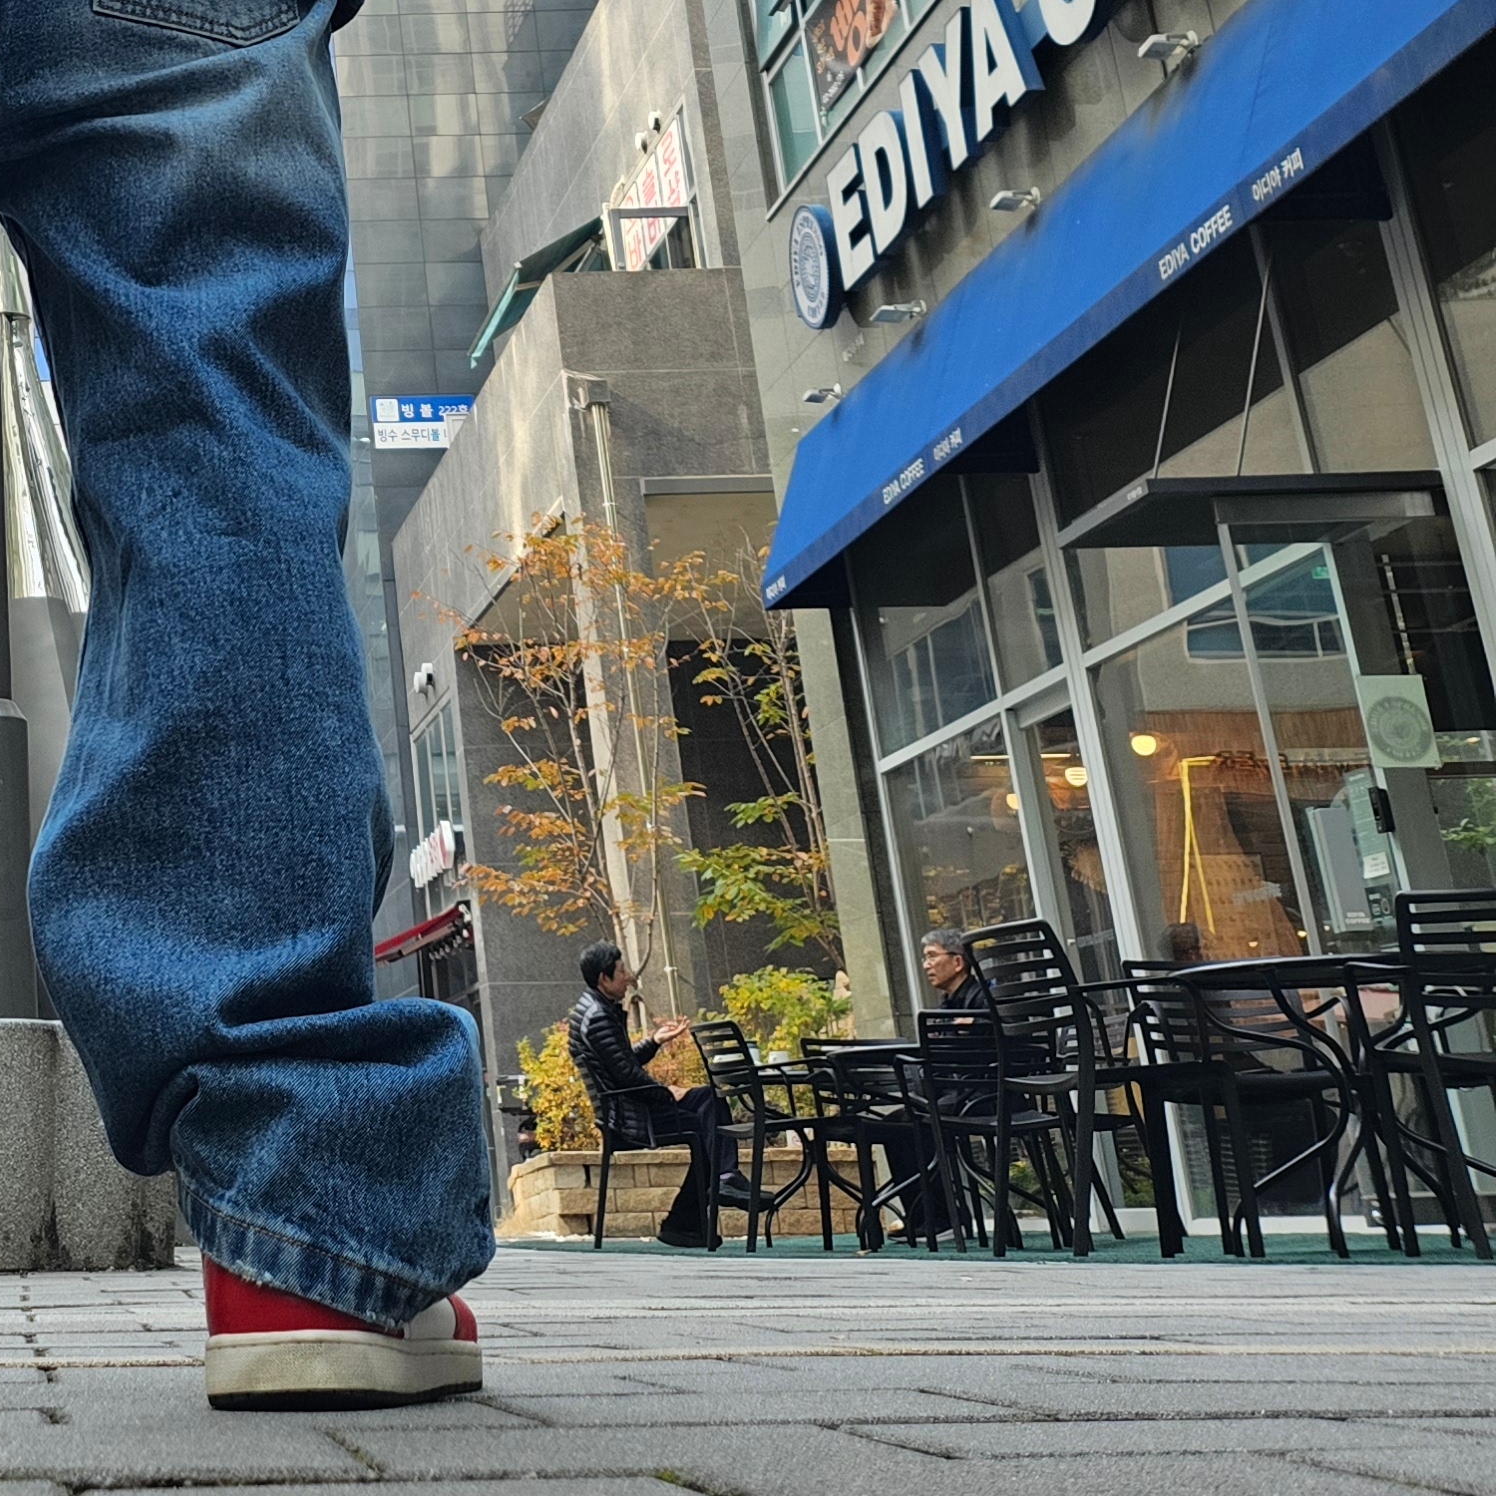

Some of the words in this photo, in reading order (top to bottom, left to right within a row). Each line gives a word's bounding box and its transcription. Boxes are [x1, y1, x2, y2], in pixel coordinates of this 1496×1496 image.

[1252, 165, 1281, 202] 이디야
[1281, 147, 1304, 179] 커피
[1158, 242, 1190, 280] EDIYA
[1190, 204, 1233, 254] COFFEE
[401, 403, 415, 418] 빙
[419, 403, 434, 418] 볼
[377, 428, 398, 443] 빙수
[401, 428, 440, 442] 스무디볼
[882, 479, 901, 504] EDIYA
[900, 458, 925, 490] COFFEE
